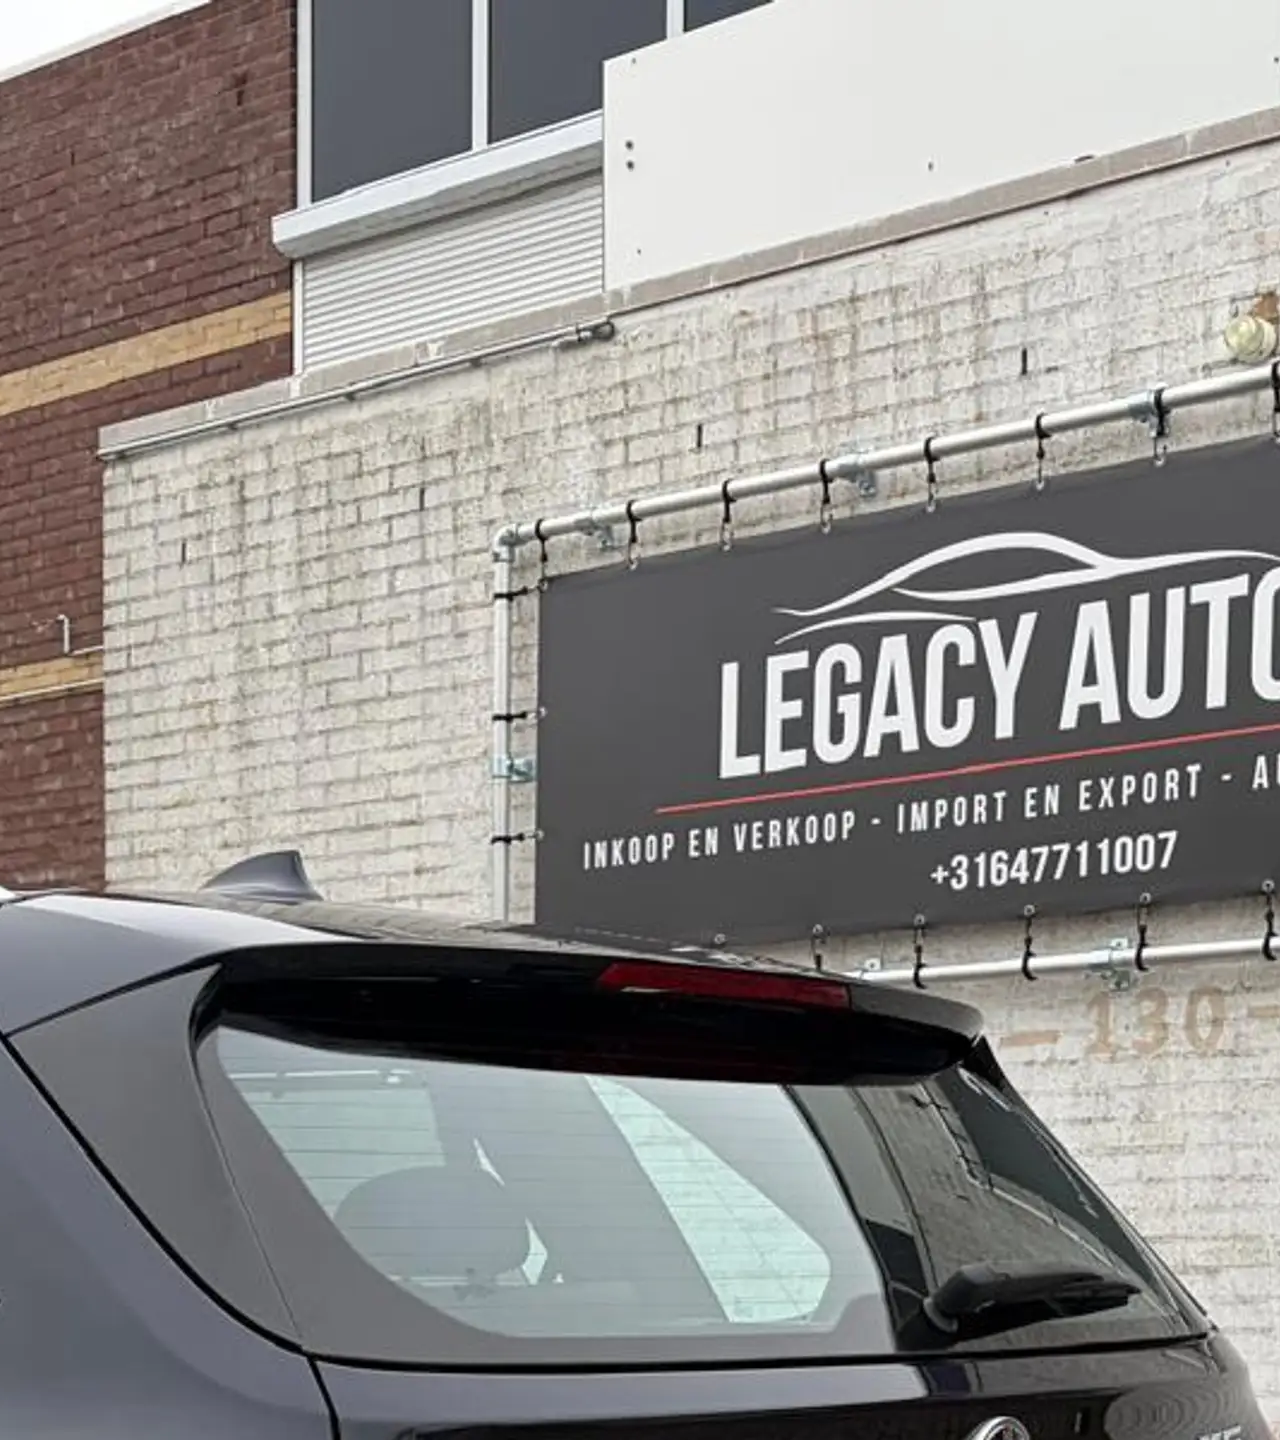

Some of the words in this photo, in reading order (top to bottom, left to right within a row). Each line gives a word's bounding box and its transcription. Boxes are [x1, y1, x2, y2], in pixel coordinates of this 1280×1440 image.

[720, 612, 1038, 779] LEGACY
[583, 832, 675, 870] INKOOP
[688, 827, 719, 858] EN
[733, 810, 855, 853] VERKOOP
[897, 790, 1008, 834] IMPORT
[1024, 784, 1060, 819] EN
[1078, 763, 1202, 811] EXPORT
[931, 830, 1178, 891] +31647711007
